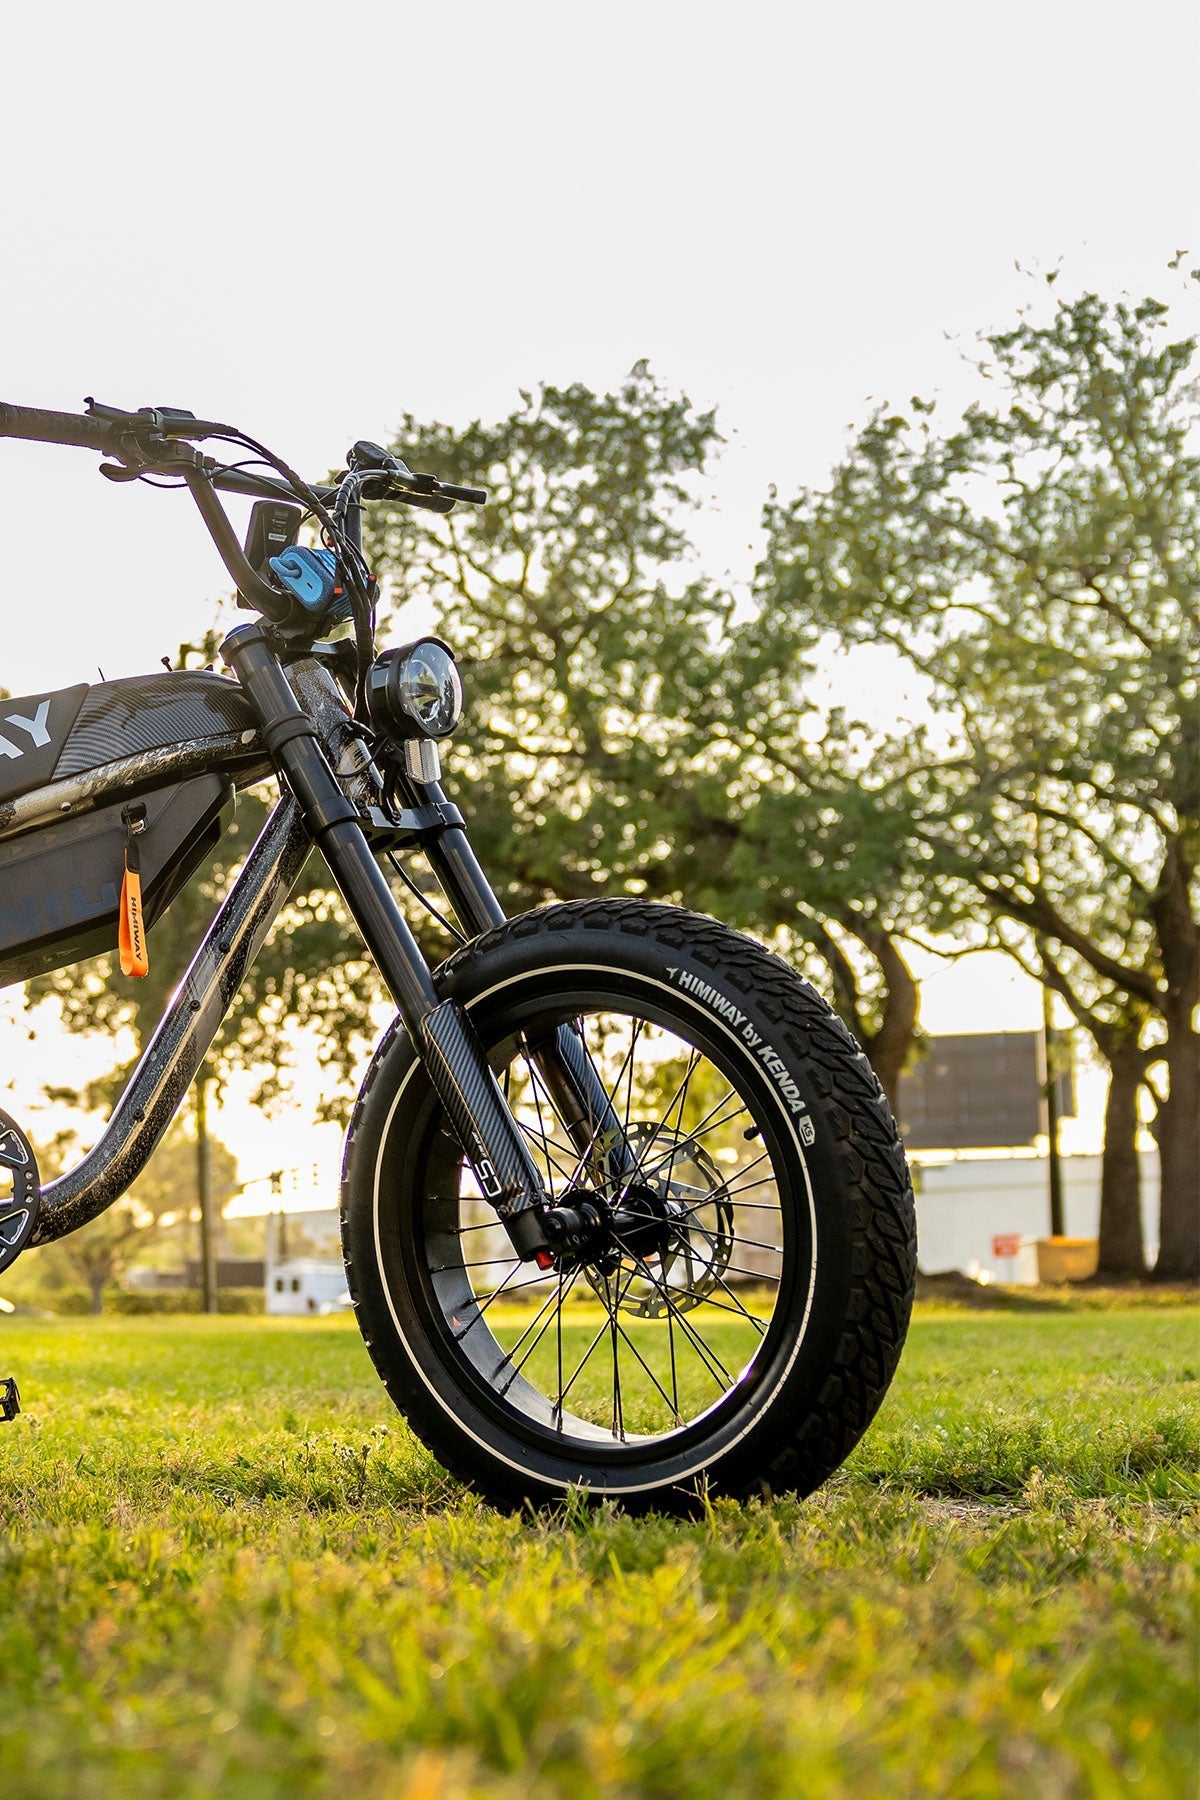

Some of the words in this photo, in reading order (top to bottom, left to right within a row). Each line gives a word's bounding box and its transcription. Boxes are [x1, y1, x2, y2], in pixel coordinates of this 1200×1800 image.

[131, 897, 142, 961] HIMIWAY
[678, 971, 748, 1028] HIMIWAY
[742, 1023, 762, 1048] by
[757, 1045, 806, 1114] KENDA
[474, 1160, 502, 1197] C5
